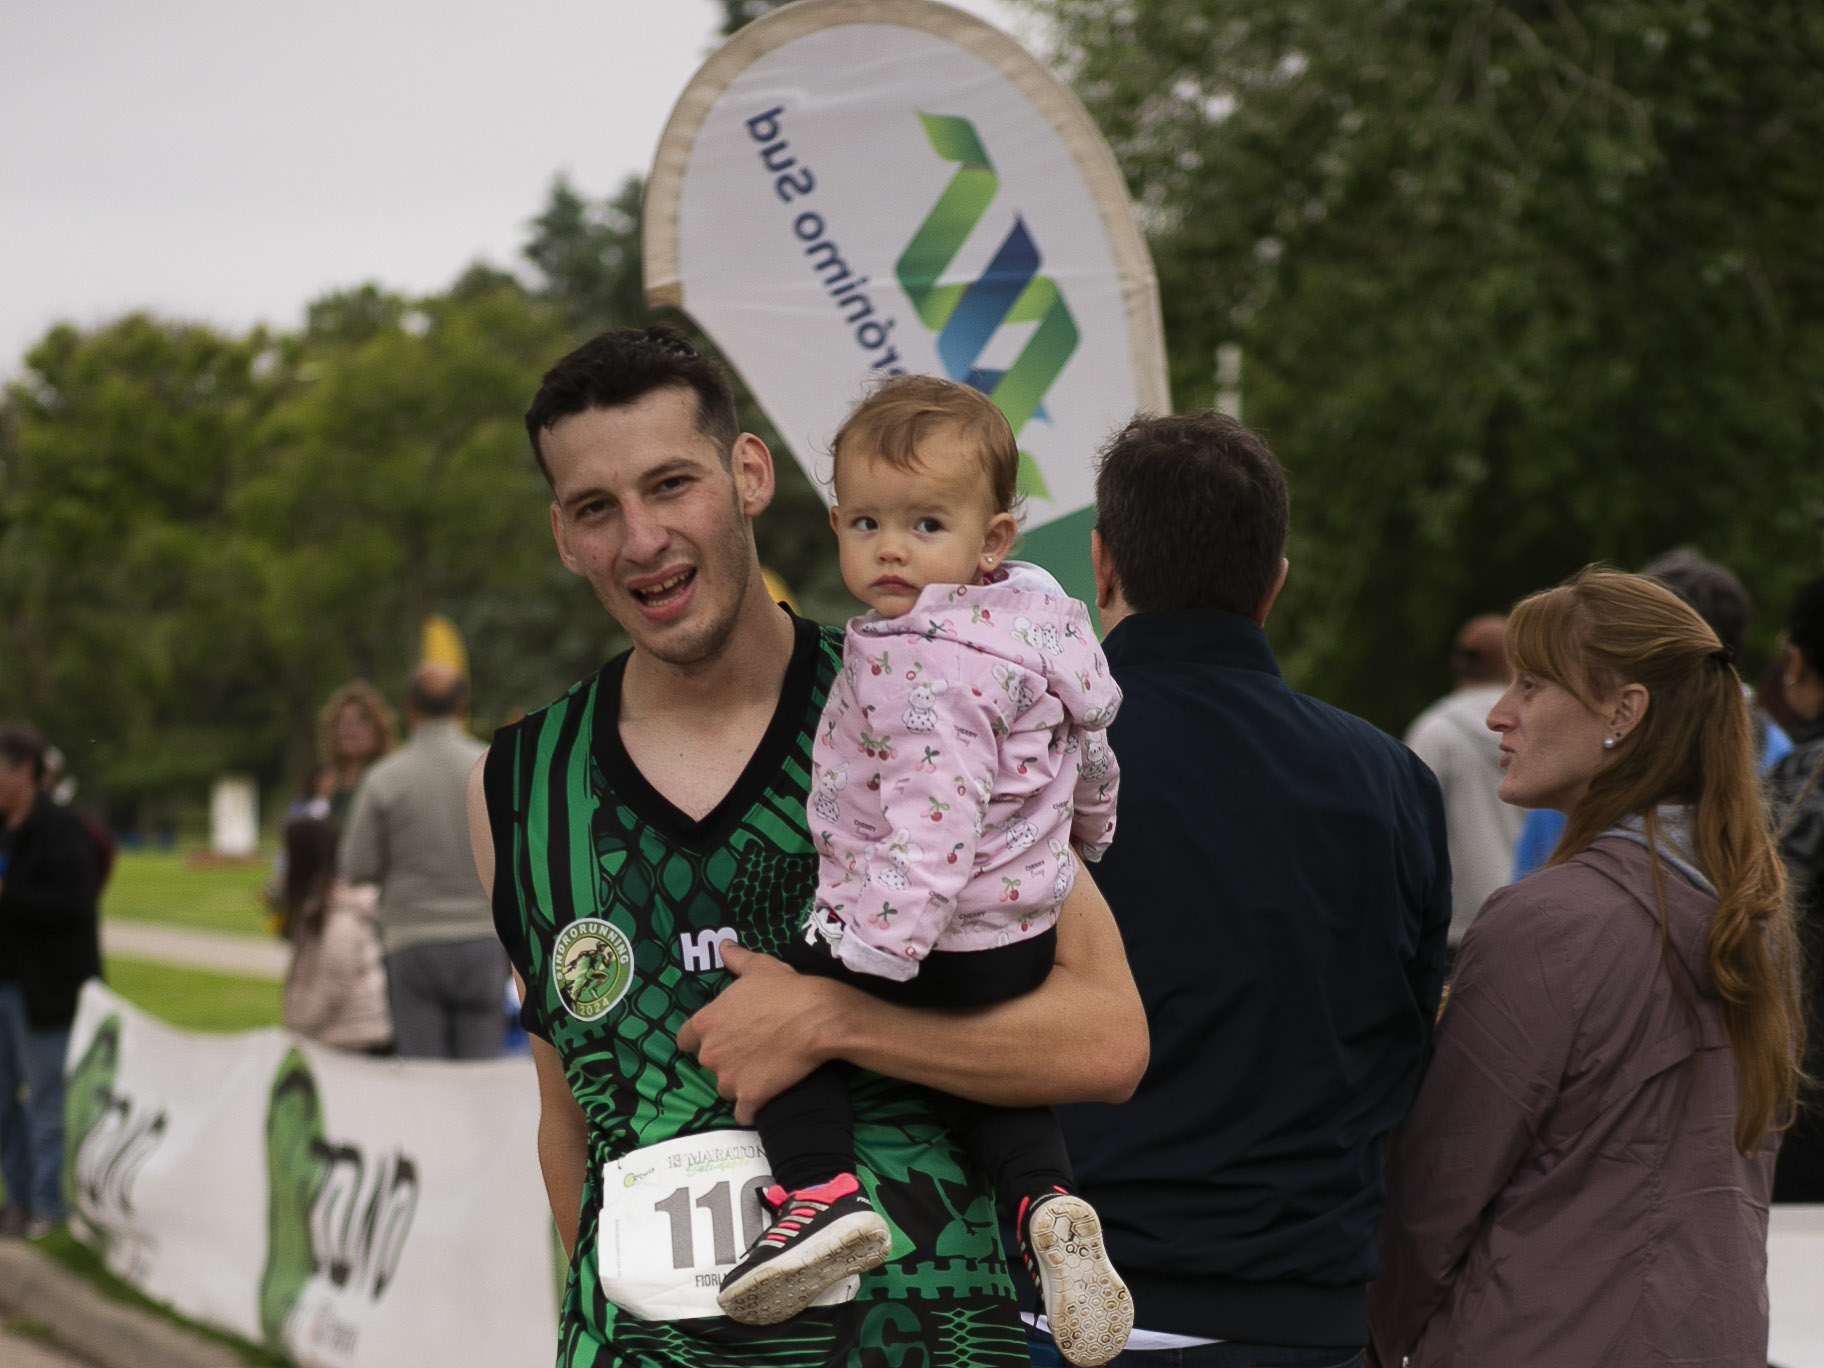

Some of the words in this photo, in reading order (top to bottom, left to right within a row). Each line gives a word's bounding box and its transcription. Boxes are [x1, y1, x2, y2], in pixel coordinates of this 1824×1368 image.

[1025, 860, 1045, 872] CHERRY
[958, 911, 986, 920] CHERRY
[556, 923, 629, 980] SINDRORUNNING
[680, 926, 738, 971] HM
[580, 1001, 610, 1016] 2024
